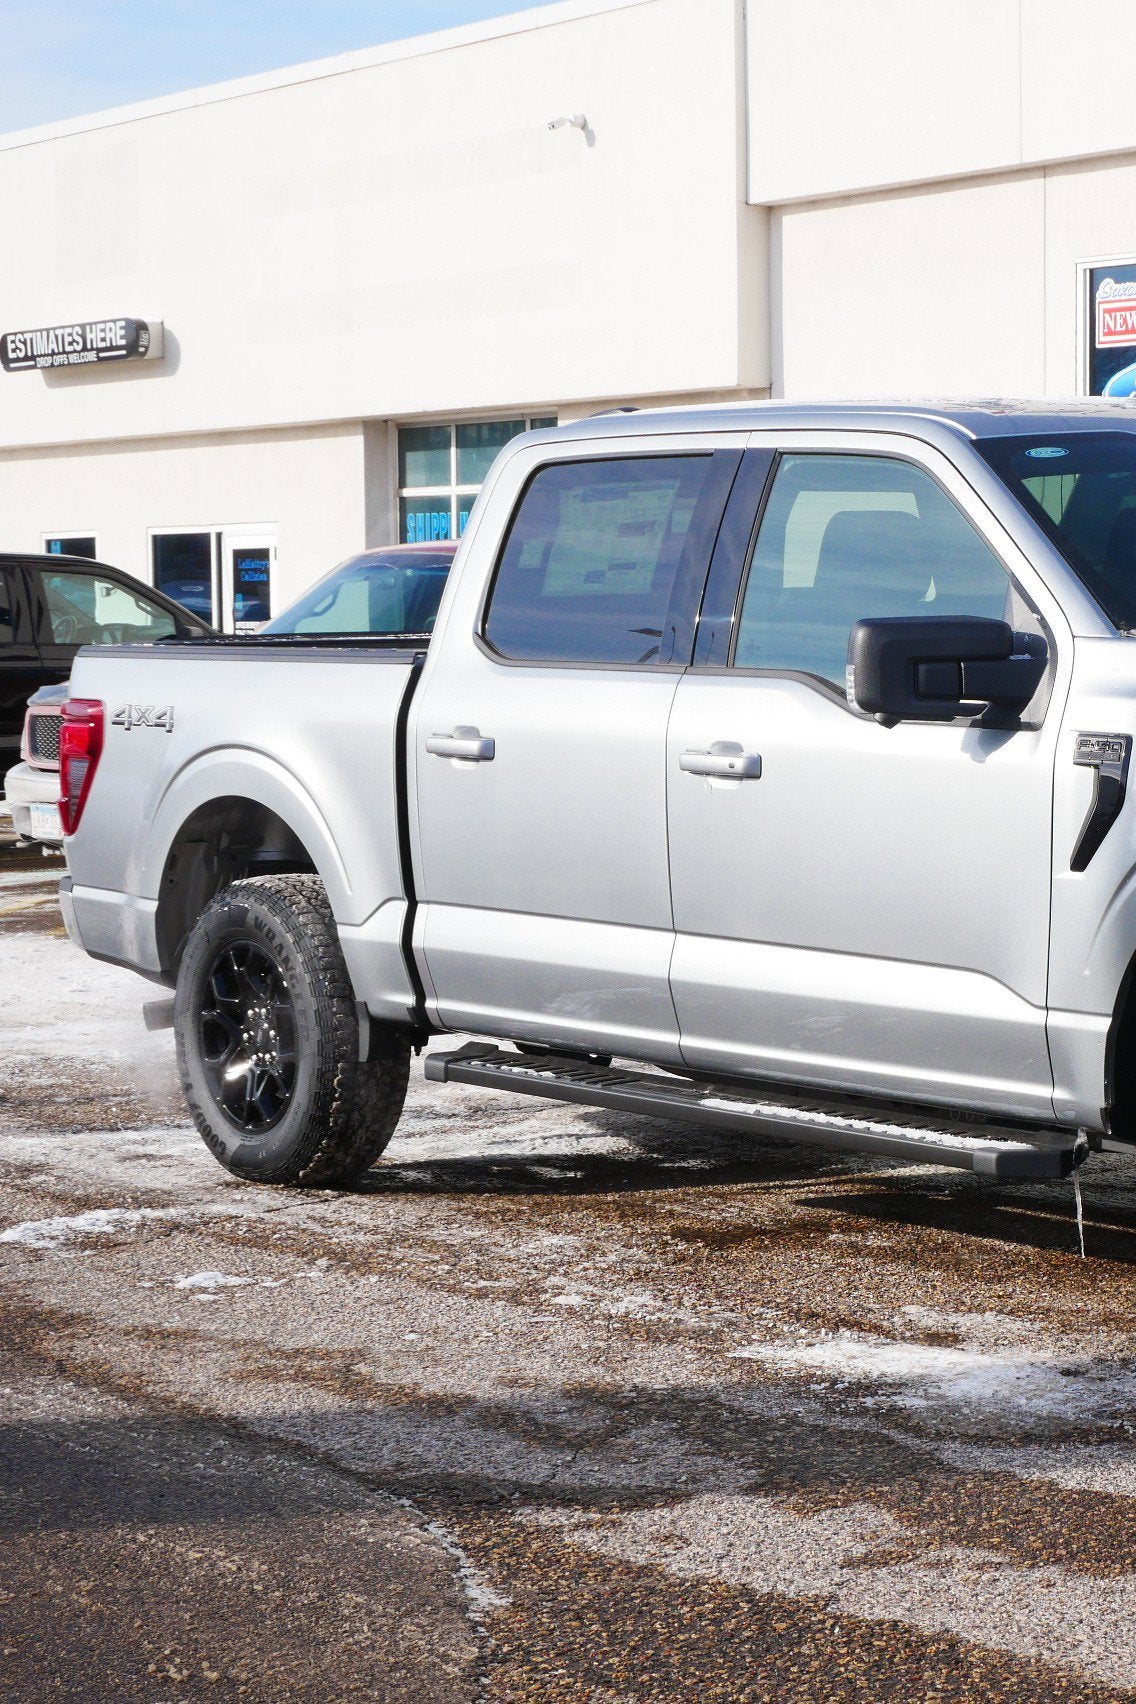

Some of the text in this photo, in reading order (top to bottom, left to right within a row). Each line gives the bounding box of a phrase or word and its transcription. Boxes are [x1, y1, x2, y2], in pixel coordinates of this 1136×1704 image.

[7, 325, 83, 359] ESTIMATES
[86, 320, 127, 349] HERE
[36, 351, 98, 368] DROP OFFS WELCOME
